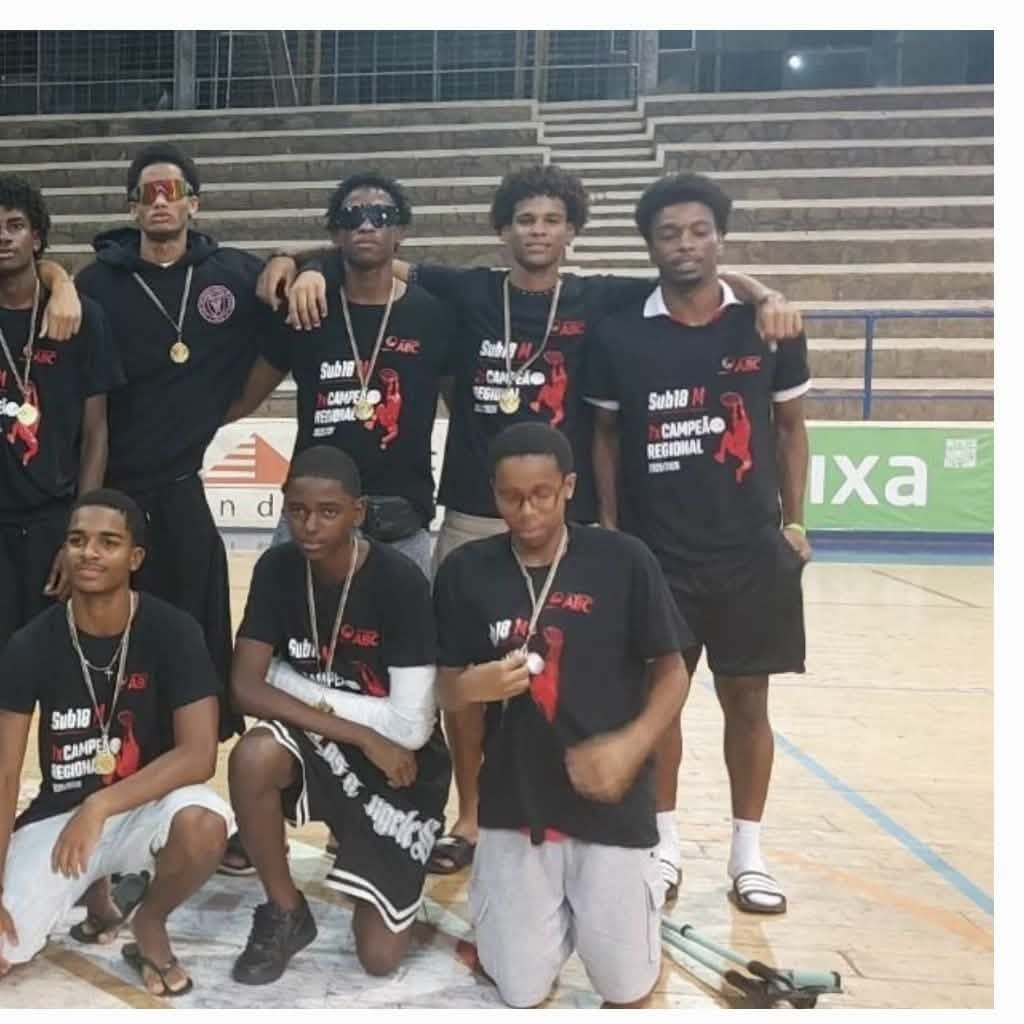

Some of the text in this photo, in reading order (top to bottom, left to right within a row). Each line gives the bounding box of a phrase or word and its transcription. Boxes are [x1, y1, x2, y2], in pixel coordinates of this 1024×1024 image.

[396, 339, 423, 355] ABC
[319, 360, 356, 380] Sub18
[647, 386, 706, 411] Sub18 M
[646, 439, 704, 460] REGIONAL
[560, 593, 593, 614] ABC
[51, 707, 92, 731] Sub18
